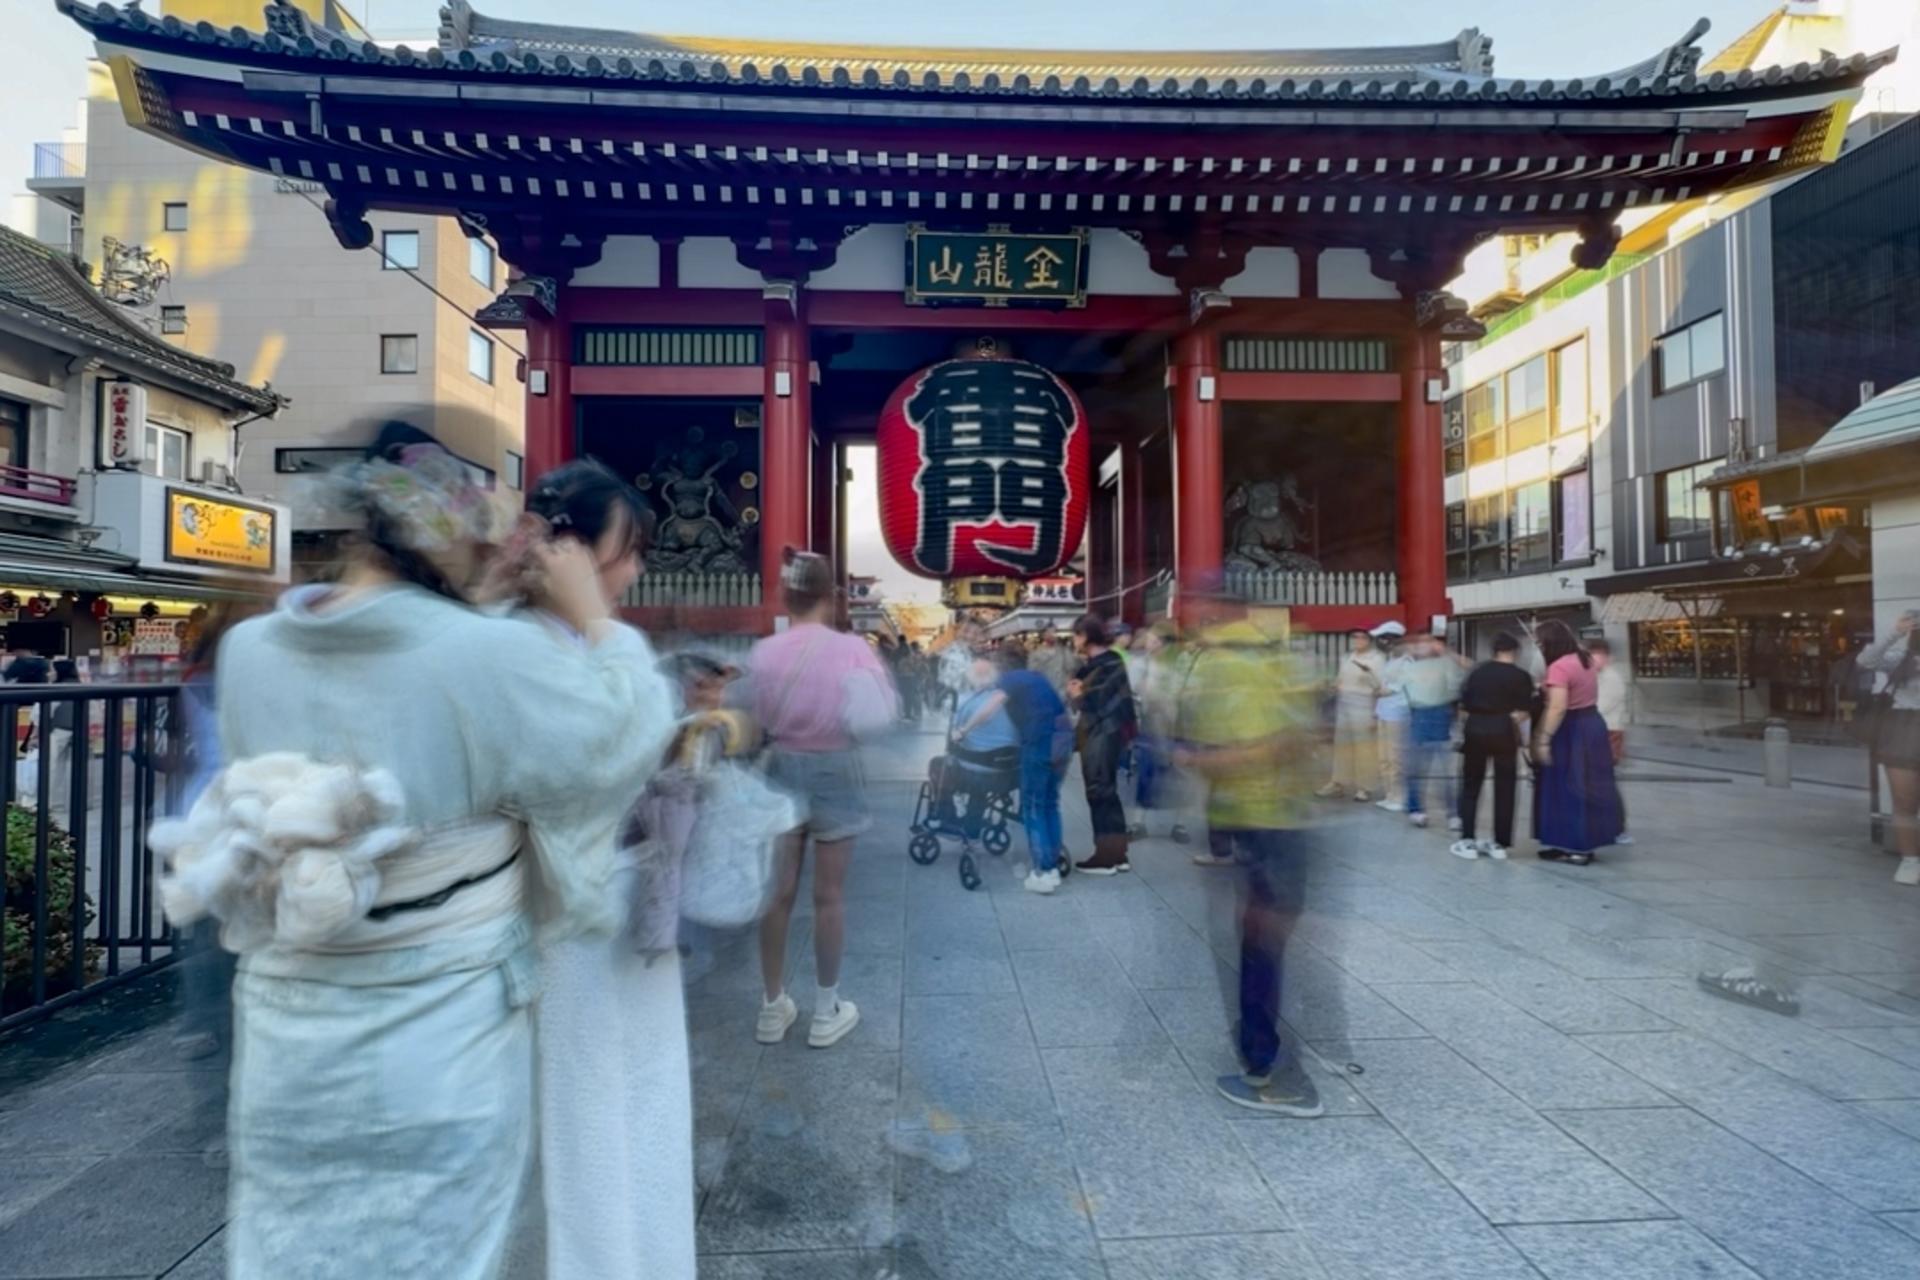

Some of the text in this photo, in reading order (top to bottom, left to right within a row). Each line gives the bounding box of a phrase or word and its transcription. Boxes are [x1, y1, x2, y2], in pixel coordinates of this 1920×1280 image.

[929, 243, 1064, 289] 金龍山
[904, 358, 1079, 575] 雷門
